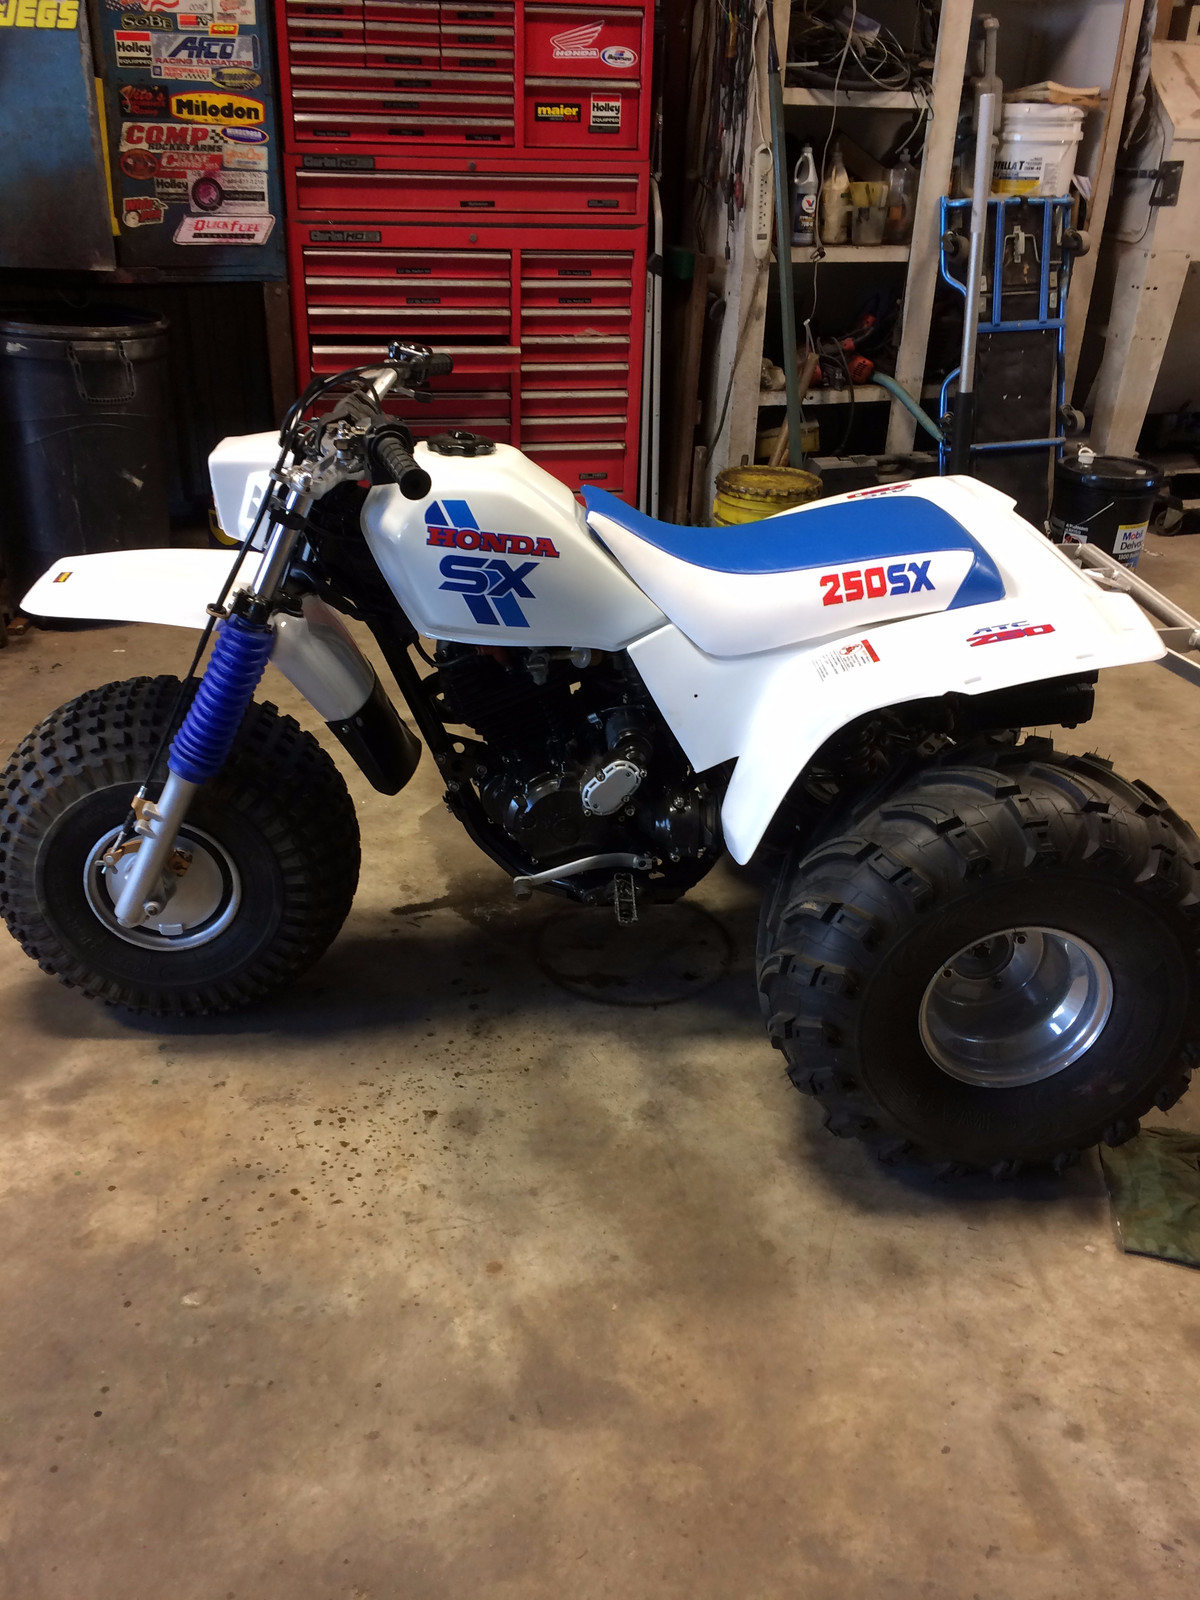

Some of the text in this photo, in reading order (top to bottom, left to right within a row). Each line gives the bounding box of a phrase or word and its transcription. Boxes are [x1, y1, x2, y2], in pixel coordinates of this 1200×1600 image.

[0, 0, 79, 29] JEGS
[117, 41, 151, 55] Holley
[197, 58, 253, 67] RADIATORS
[176, 98, 260, 120] Milodon
[537, 105, 578, 115] maier
[592, 103, 620, 115] Holley
[125, 125, 209, 145] COMP
[148, 143, 223, 153] ROCKER ARMS
[993, 161, 1017, 171] OTELLA
[156, 179, 188, 191] Holley
[426, 525, 560, 558] HONDA
[1123, 530, 1144, 540] Mobil
[438, 554, 540, 599] SX
[973, 620, 1031, 635] ATC
[966, 623, 1056, 647] 250
